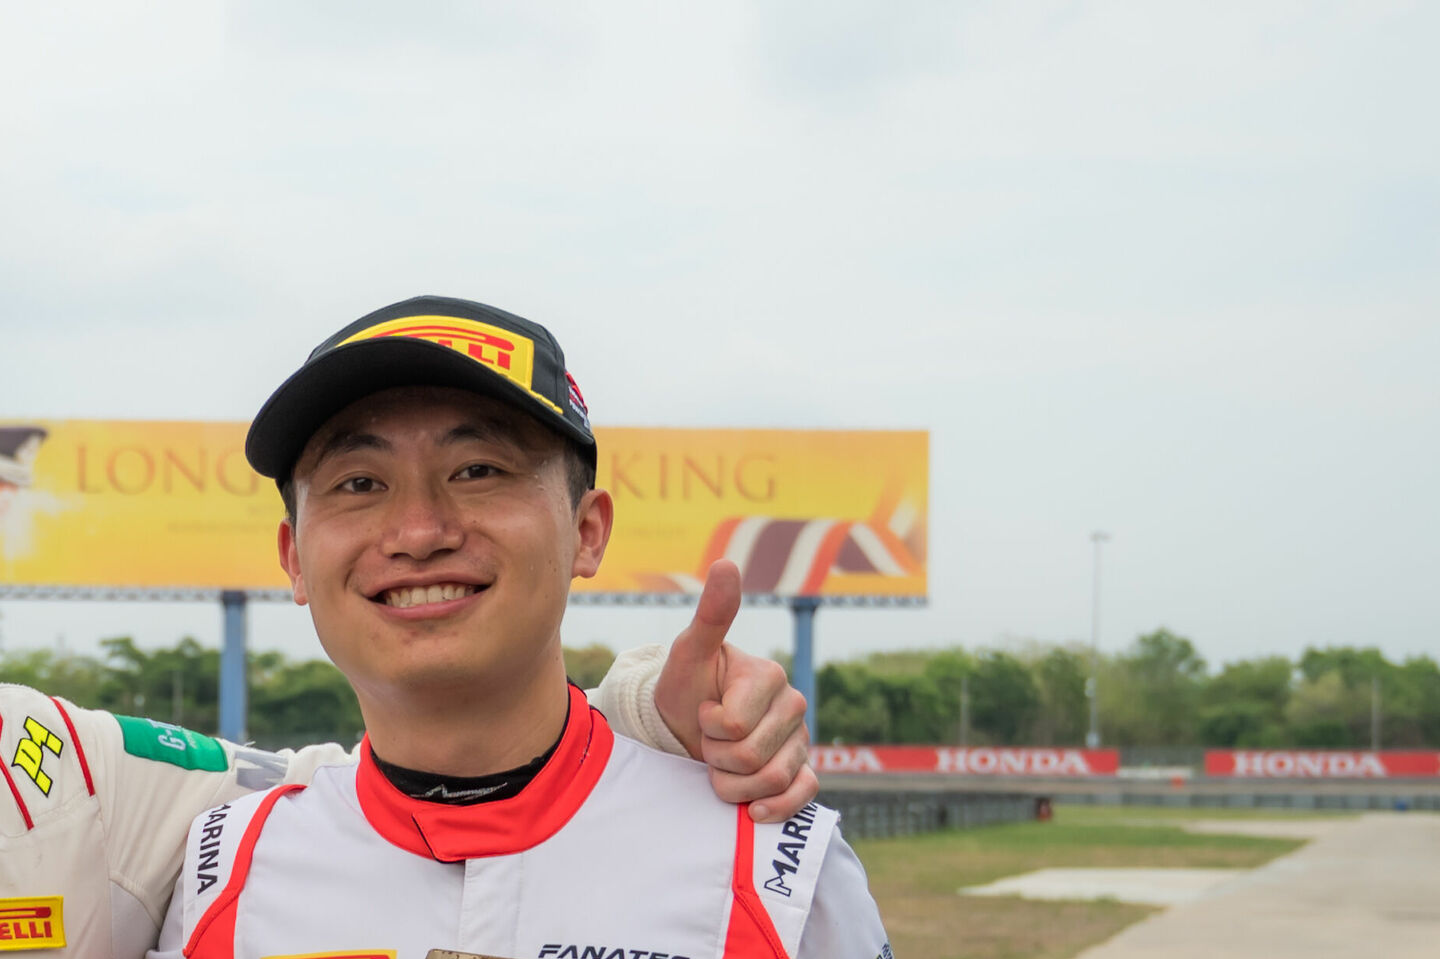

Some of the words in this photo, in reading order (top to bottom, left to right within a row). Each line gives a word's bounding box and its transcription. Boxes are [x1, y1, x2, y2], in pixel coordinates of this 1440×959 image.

[76, 445, 260, 497] LONG
[611, 453, 777, 502] KING
[935, 749, 1091, 773] HONDA
[1233, 751, 1388, 777] HONDA
[764, 801, 818, 897] MARIN
